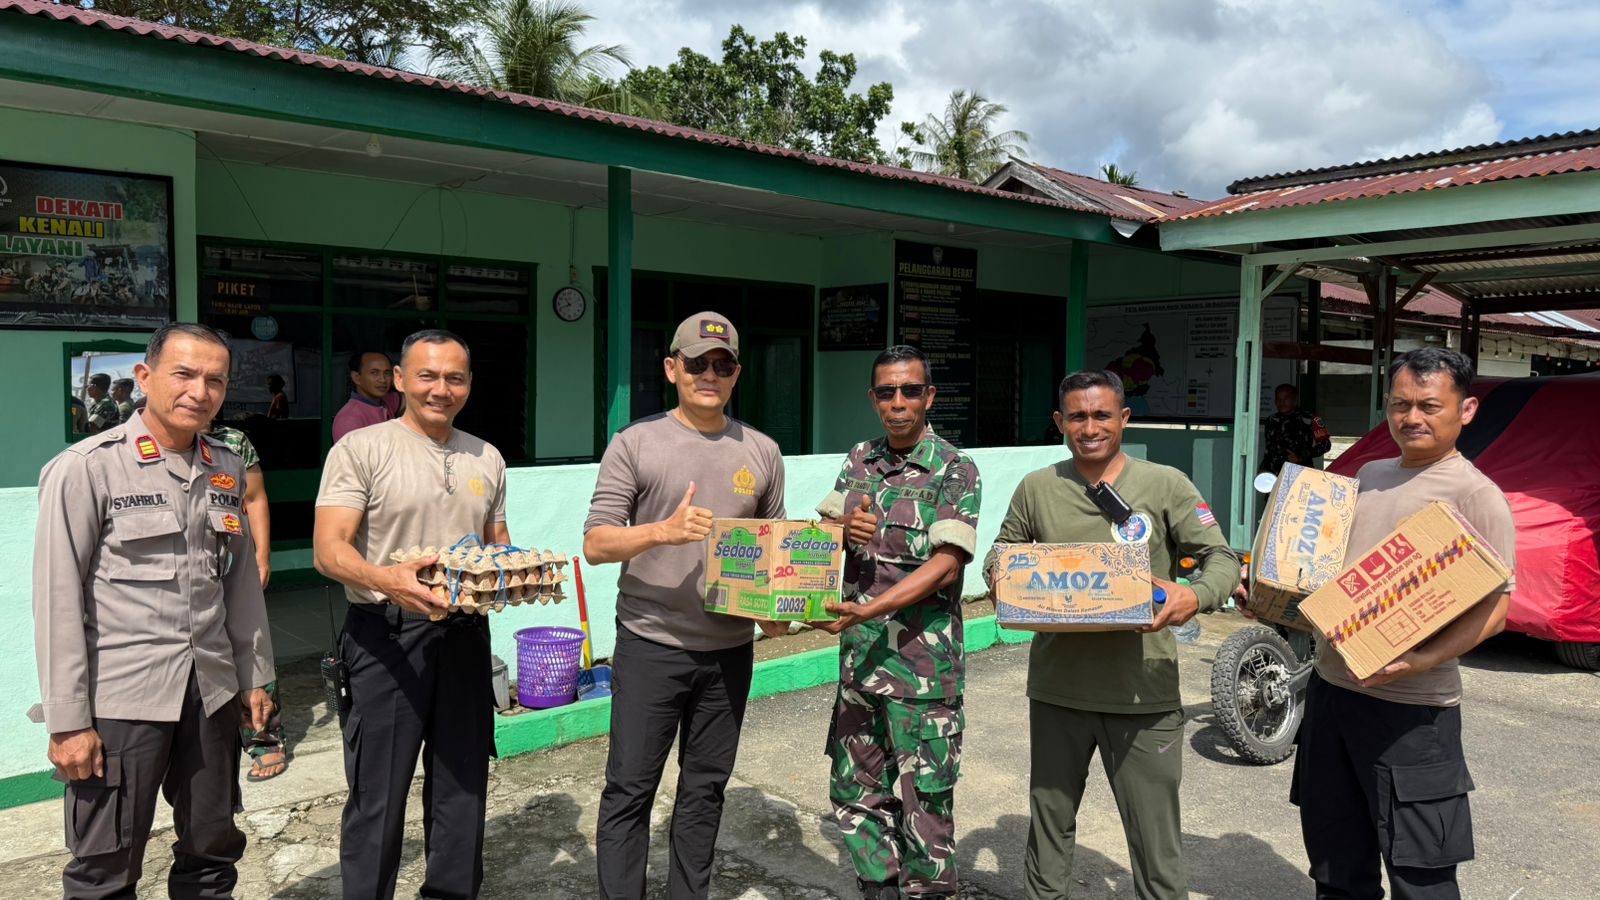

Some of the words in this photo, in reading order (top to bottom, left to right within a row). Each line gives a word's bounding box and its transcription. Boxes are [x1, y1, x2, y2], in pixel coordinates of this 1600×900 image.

[36, 196, 123, 220] DEKATI
[19, 215, 104, 238] KENALI
[0, 234, 84, 257] LAYANI
[899, 262, 951, 277] PELANGGARAN
[952, 267, 973, 278] BERAT
[217, 281, 256, 296] PIKET
[113, 493, 167, 510] SYAHRUL
[209, 493, 239, 508] POLRI
[1297, 490, 1327, 555] AMOZ
[714, 541, 763, 563] Sedaap
[780, 537, 839, 554] Sedaap
[1026, 571, 1110, 590] AMOZ
[776, 596, 806, 613] 20032
